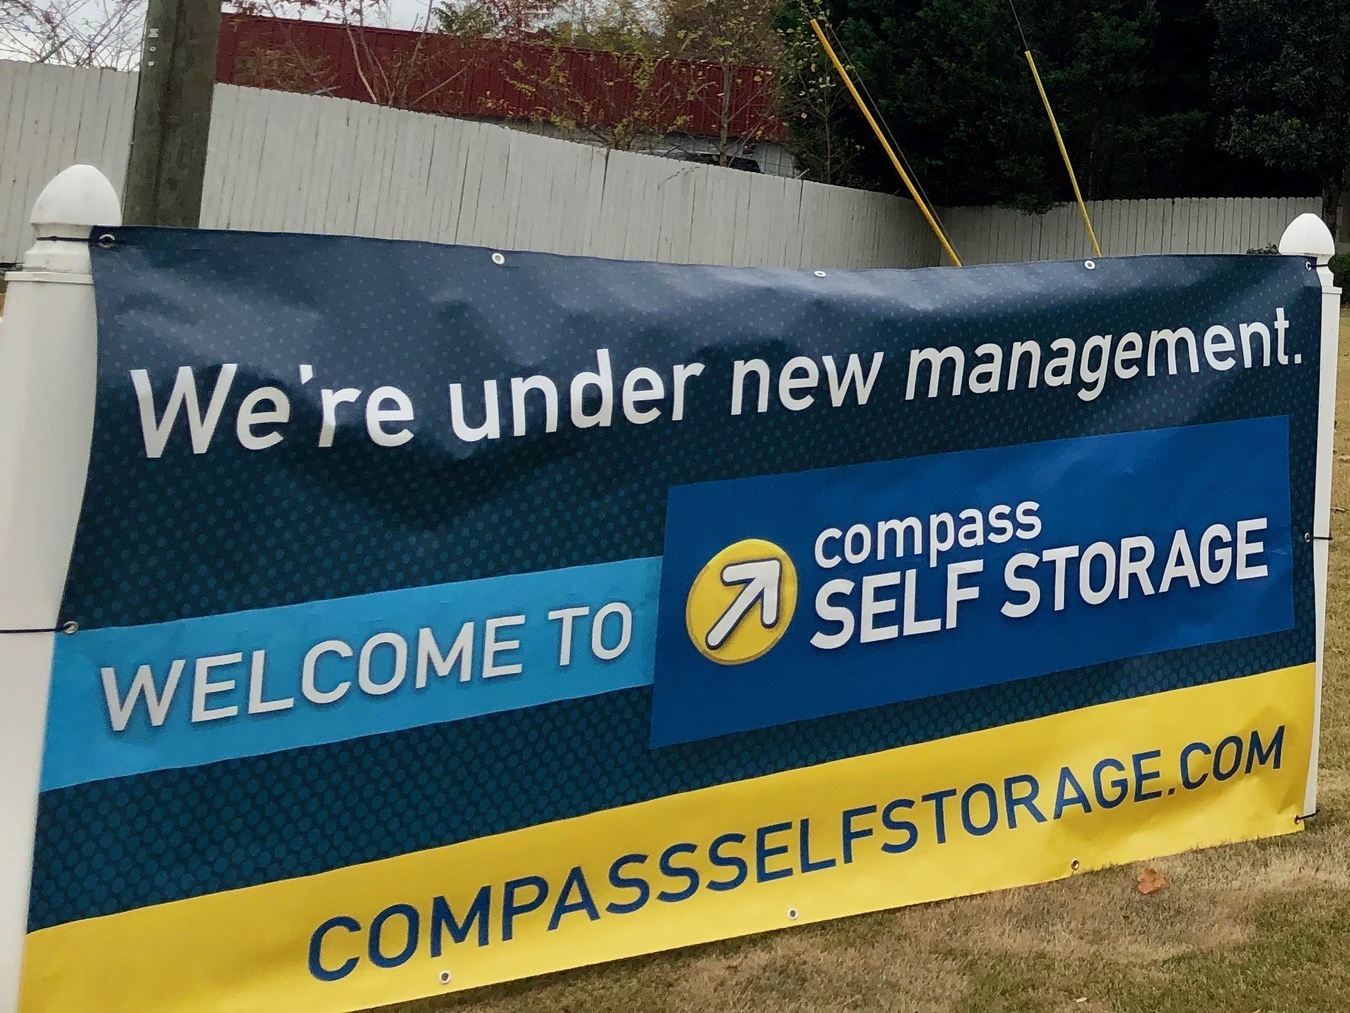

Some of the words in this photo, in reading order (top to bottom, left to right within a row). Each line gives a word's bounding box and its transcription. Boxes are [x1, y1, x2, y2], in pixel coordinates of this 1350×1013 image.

[130, 363, 415, 458] We're
[449, 348, 702, 441] under
[730, 352, 883, 416] new
[904, 308, 1302, 401] management.
[810, 560, 983, 649] SELF
[1001, 518, 1268, 618] STORAGE
[814, 501, 1042, 568] compass
[101, 614, 525, 731] WELCOME
[547, 602, 632, 666] TO
[309, 726, 1286, 982] COMPASSSELFSTORAGE.COM
